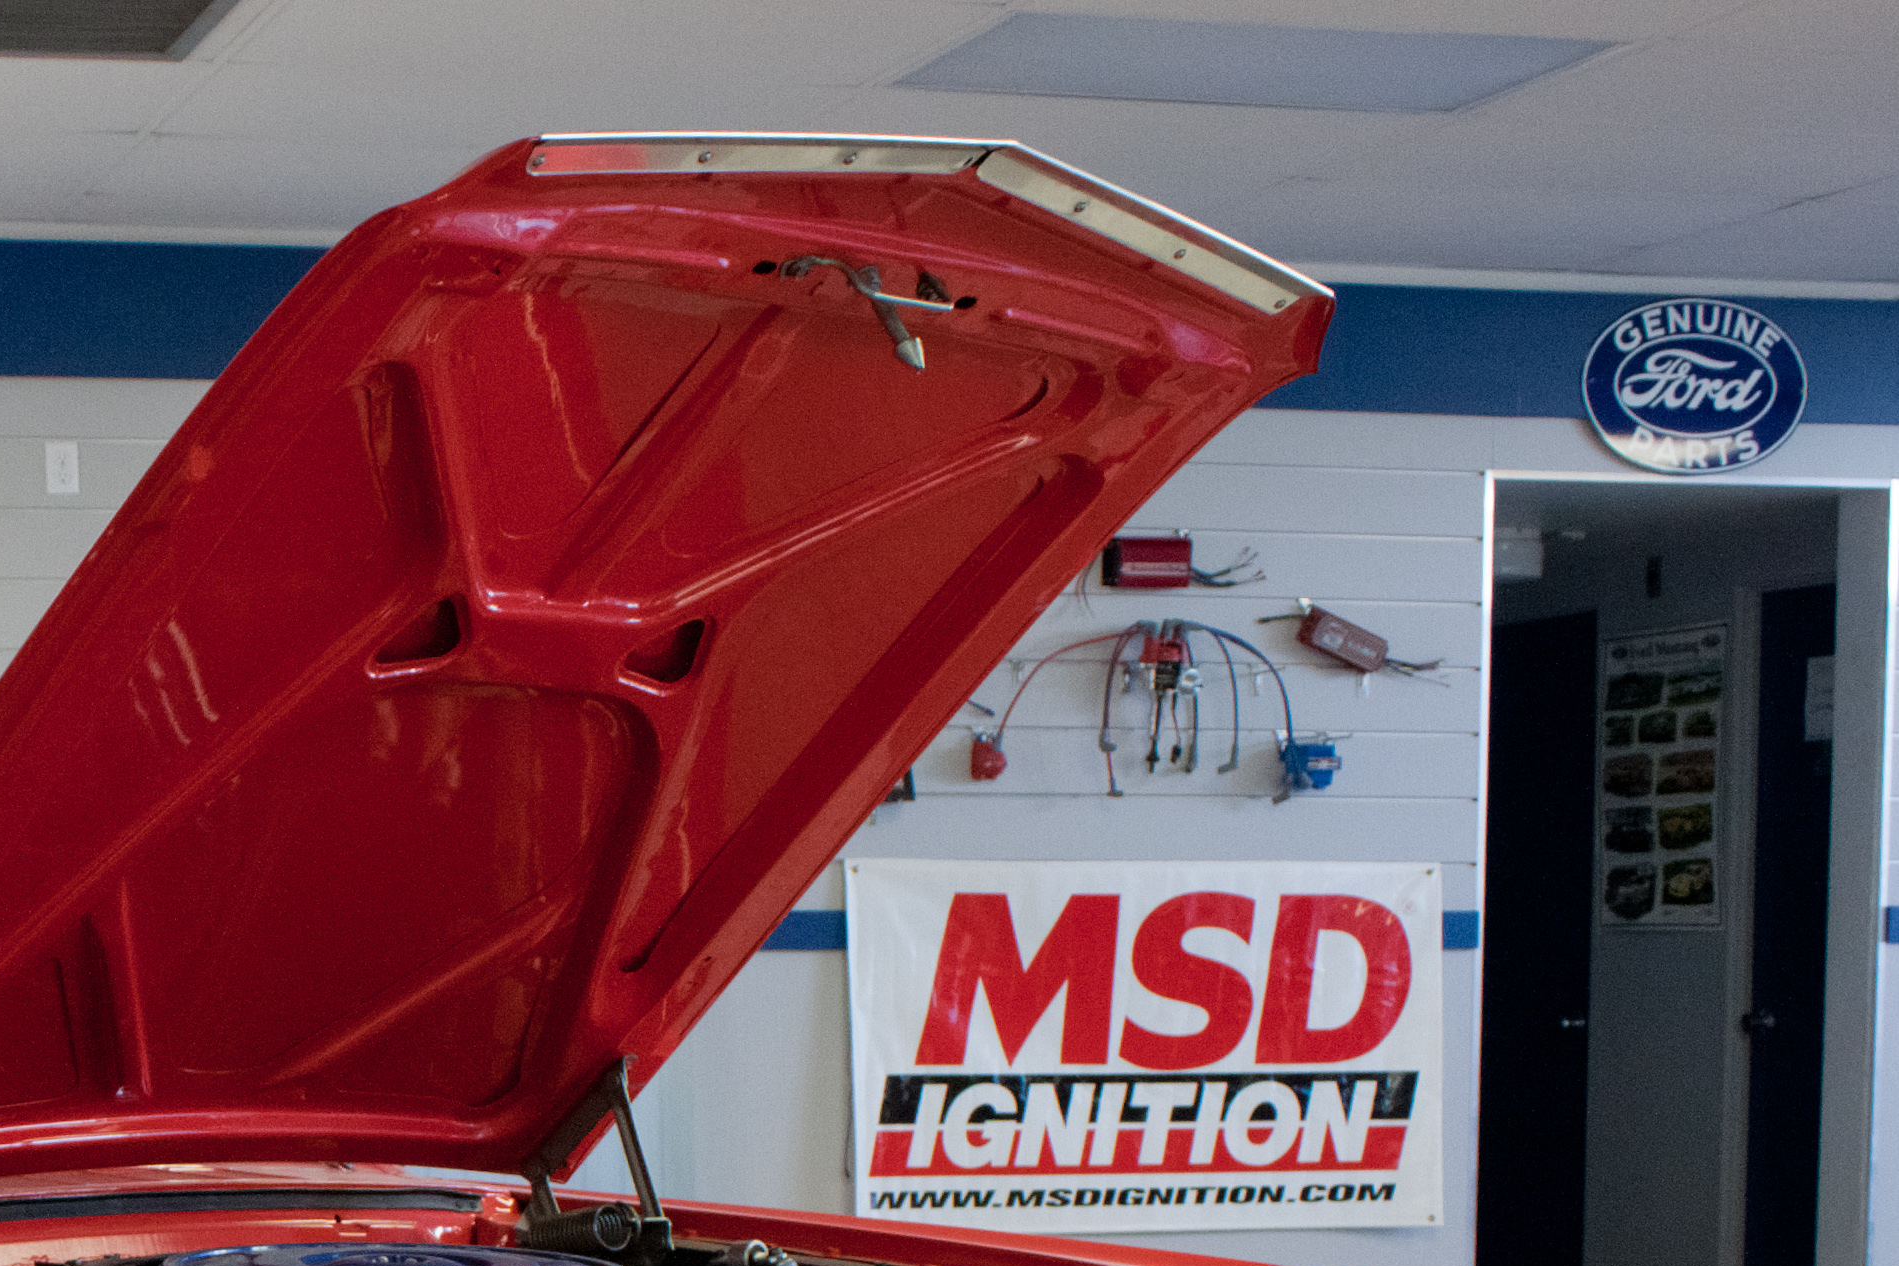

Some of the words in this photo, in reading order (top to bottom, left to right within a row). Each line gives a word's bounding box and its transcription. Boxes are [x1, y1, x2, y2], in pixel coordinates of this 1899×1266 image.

[1613, 304, 1781, 358] GENUINE
[1620, 349, 1765, 412] Ford
[1628, 425, 1760, 469] PARTS
[915, 891, 1412, 1071] MSD
[906, 1079, 1379, 1169] IGNITION
[869, 1183, 1397, 1210] WWW.MSDIGNITION.COM
